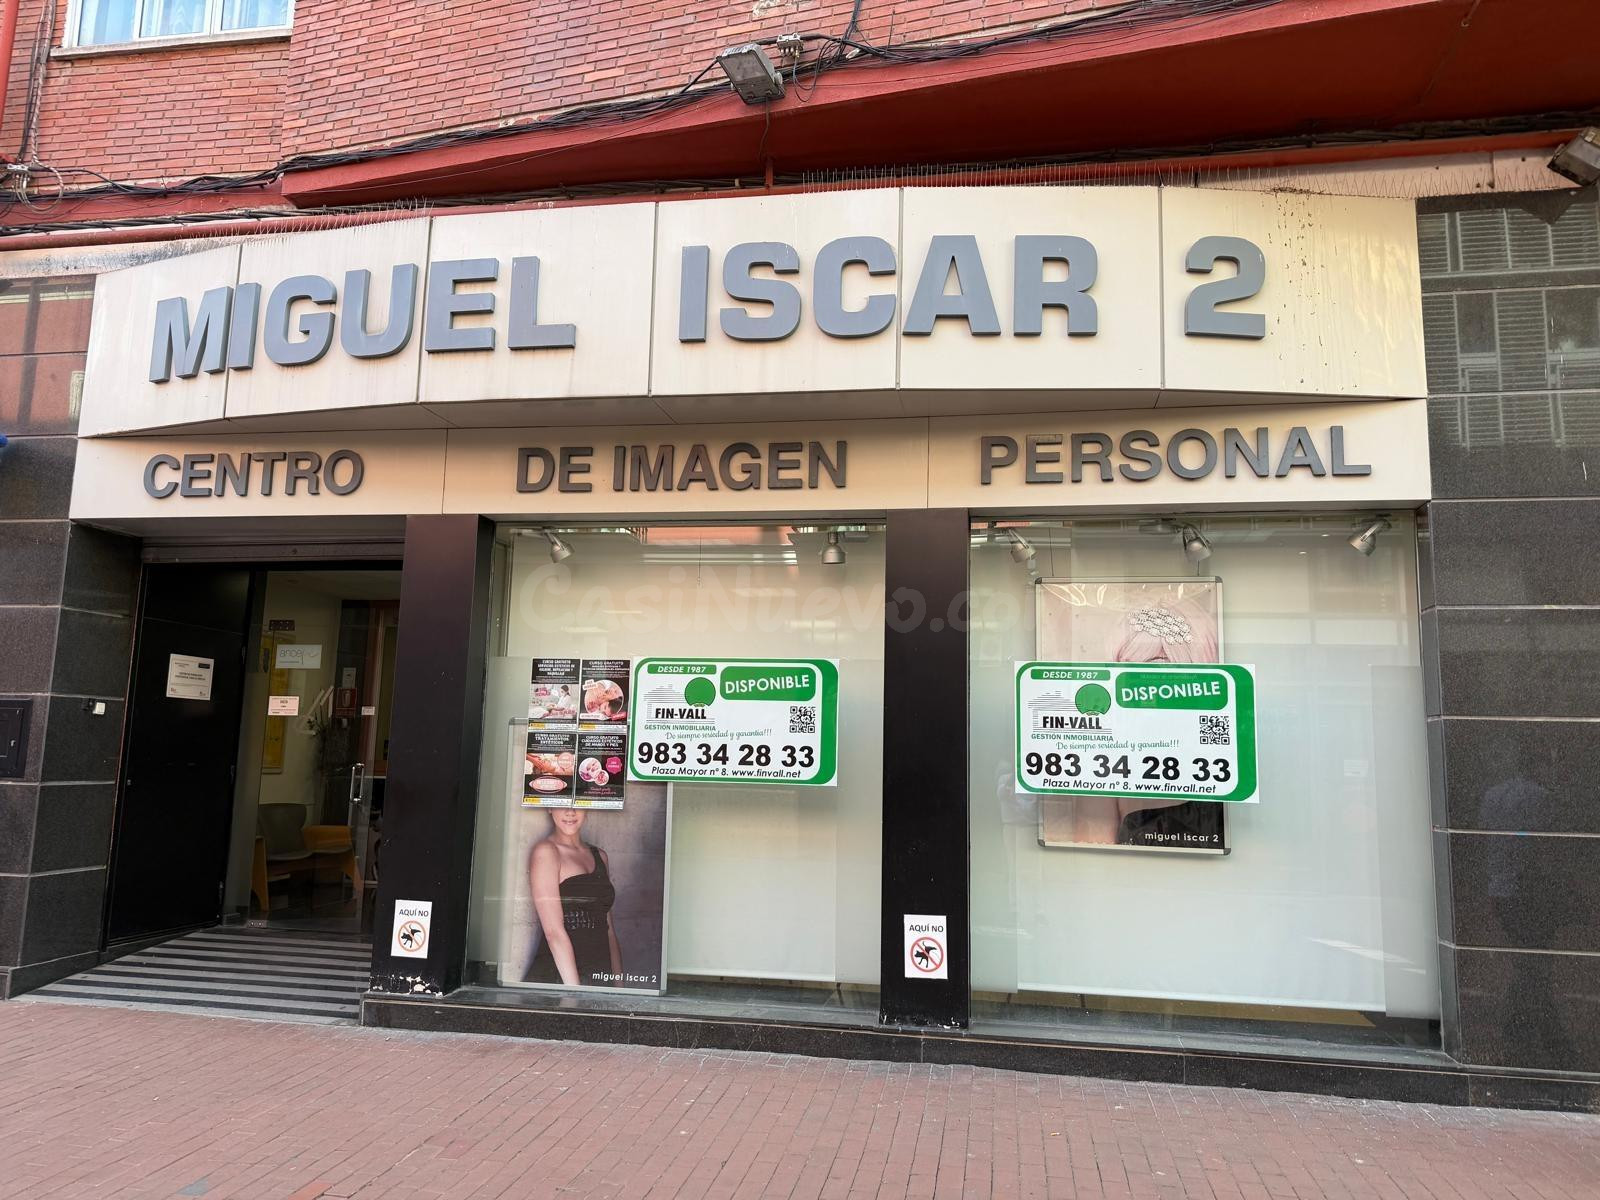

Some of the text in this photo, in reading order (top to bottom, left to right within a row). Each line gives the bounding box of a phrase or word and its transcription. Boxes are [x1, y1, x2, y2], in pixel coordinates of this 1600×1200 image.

[149, 235, 1266, 384] MIGUEL ISCAR 2
[143, 425, 1372, 499] CENTRO DE IMAGEN PERSONAL
[657, 665, 707, 674] DESDE 1987
[1042, 671, 1098, 680] DESDE 1987
[725, 674, 810, 694] DISPONIBLE
[1121, 681, 1221, 702] DISPONIBLE
[655, 707, 707, 720] FIN-VALL
[672, 724, 716, 732] INMOBILIARIA
[1042, 716, 1103, 730] FIN-VALL
[665, 732, 676, 740] De
[677, 732, 702, 742] siempre
[702, 729, 729, 738] seriedad
[729, 731, 735, 741] y
[1063, 734, 1114, 742] INMOBILIARIA
[1055, 741, 1069, 750] De
[1069, 742, 1098, 752] siempre
[1098, 740, 1129, 749] seriedad
[1130, 742, 1136, 752] y
[638, 741, 815, 768] 983 34 28 33
[651, 766, 676, 775] Plaza
[678, 767, 707, 777] Mayor
[721, 768, 729, 776] 8.
[731, 768, 801, 779] www.finvall.net
[1025, 751, 1231, 783] 983 34 28 33
[1043, 779, 1070, 788] Plaza
[1073, 780, 1107, 791] Mayor
[1122, 781, 1132, 790] 8.
[1135, 783, 1217, 794] www.finvall.net
[1144, 831, 1219, 842] miguel iscar 2
[399, 908, 429, 917] AQUÍ NO
[908, 923, 944, 933] AQUÍ NO
[592, 972, 657, 983] miguel iscar 2
